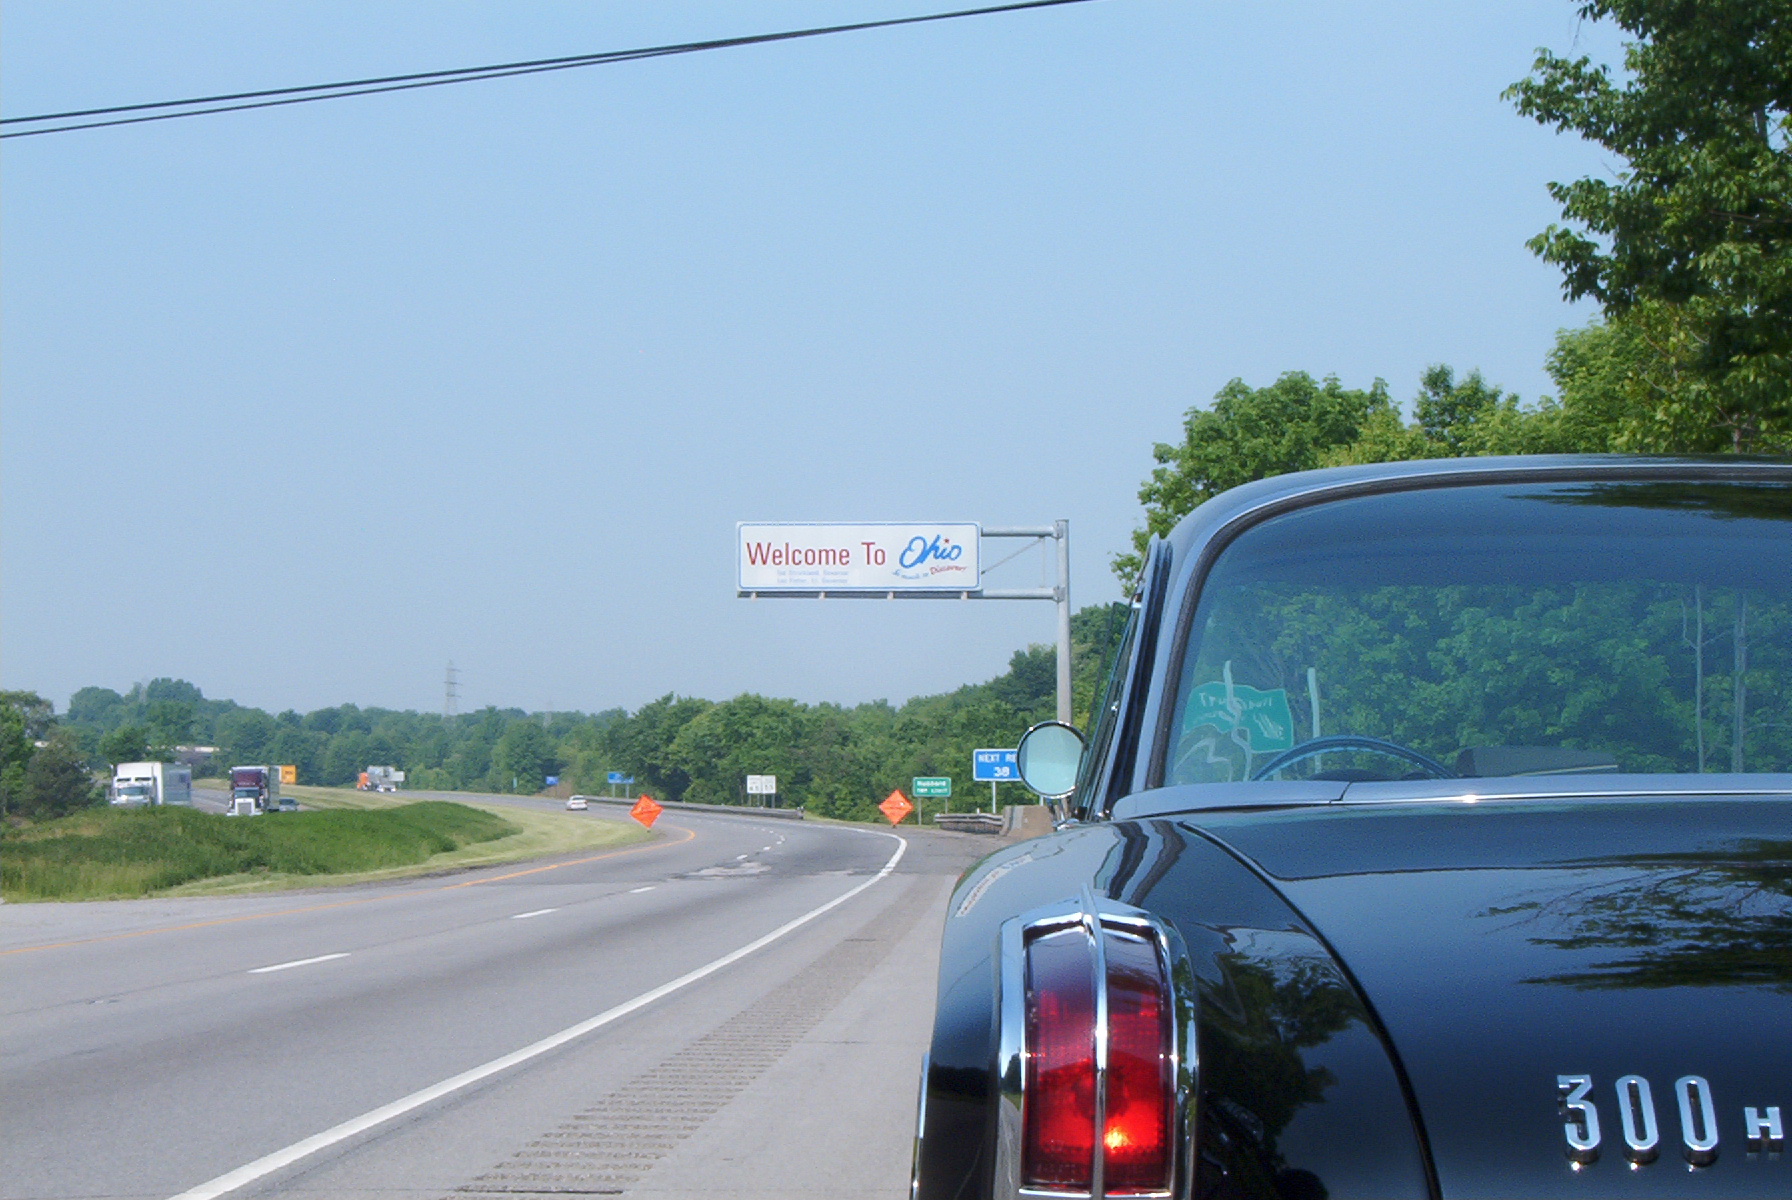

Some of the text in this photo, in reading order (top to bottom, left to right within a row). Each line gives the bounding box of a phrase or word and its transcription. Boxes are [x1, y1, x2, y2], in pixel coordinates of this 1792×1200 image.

[746, 534, 962, 568] Welcome To Ohio
[1557, 1074, 1784, 1152] 300 H
